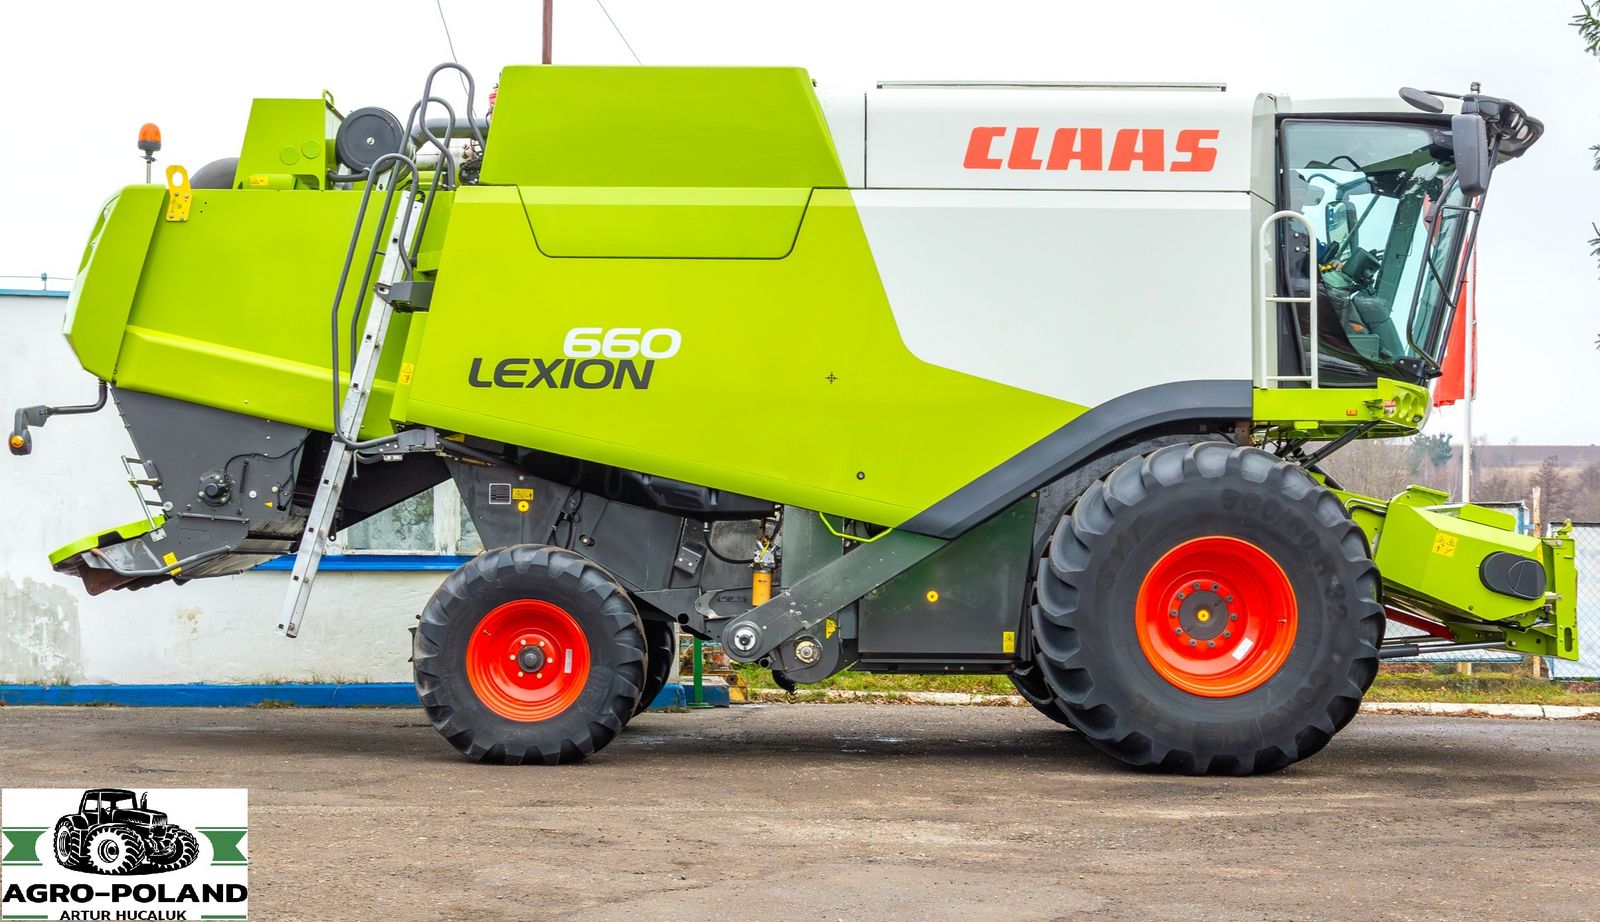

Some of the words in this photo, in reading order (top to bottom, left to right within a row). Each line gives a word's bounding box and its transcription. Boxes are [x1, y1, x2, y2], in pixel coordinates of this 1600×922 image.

[963, 126, 1219, 172] CLAAS
[563, 327, 682, 359] 660
[468, 357, 655, 390] LEXION
